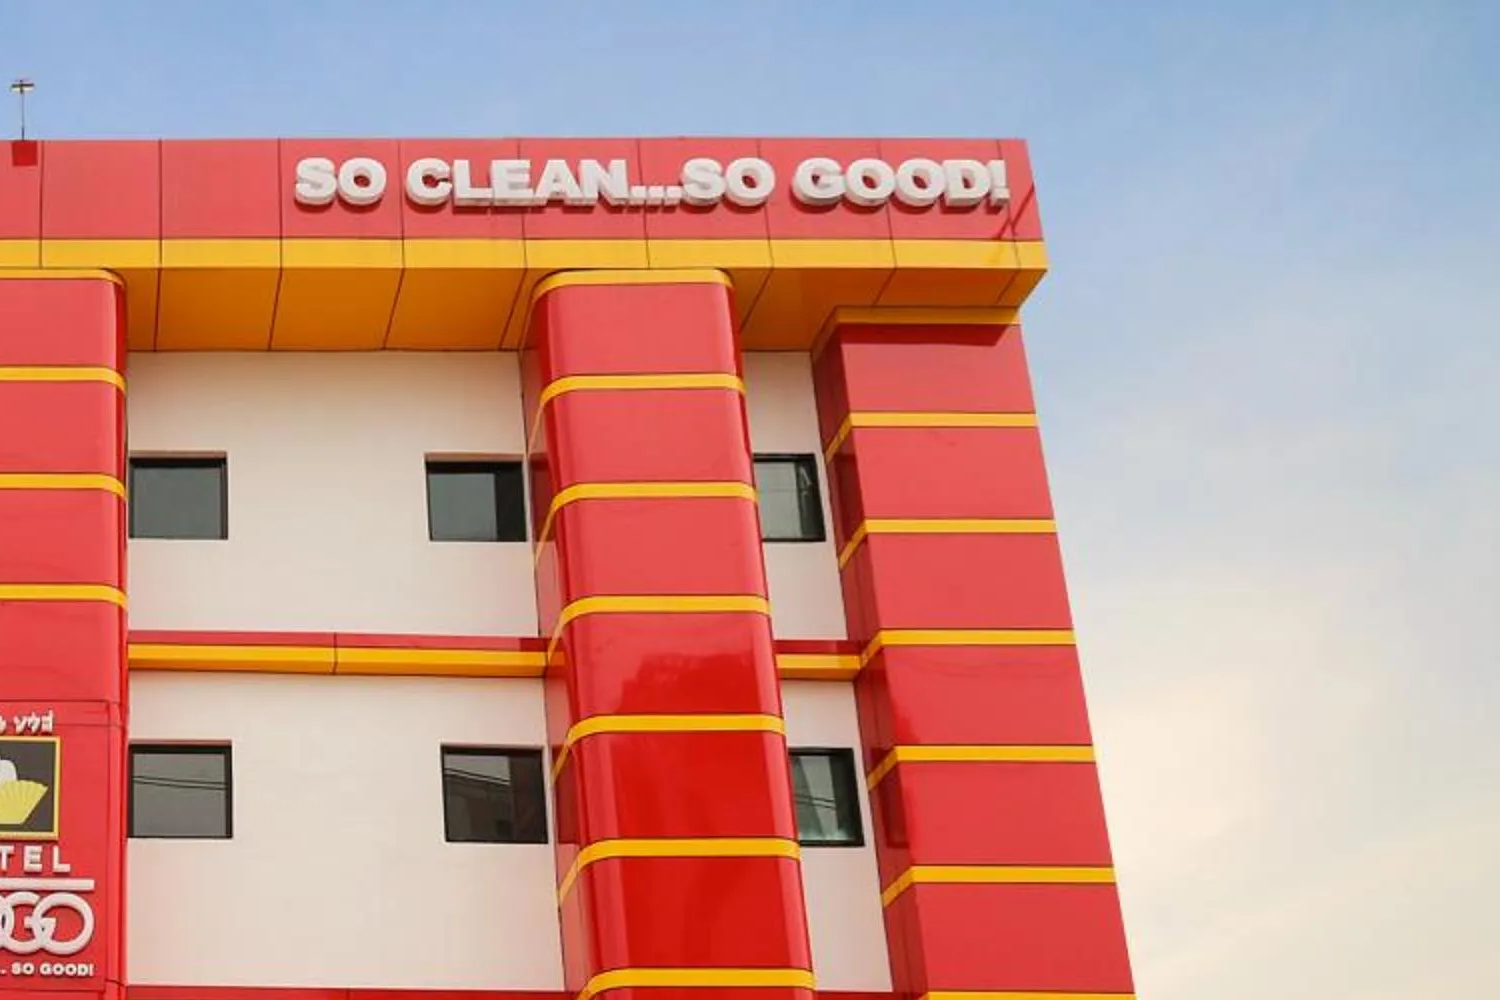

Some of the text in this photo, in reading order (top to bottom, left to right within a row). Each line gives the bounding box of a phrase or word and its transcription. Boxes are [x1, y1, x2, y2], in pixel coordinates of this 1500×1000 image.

[295, 156, 387, 206] SO
[792, 157, 1011, 208] GOOD!
[11, 963, 35, 976] SO
[40, 964, 94, 977] GOOD!
